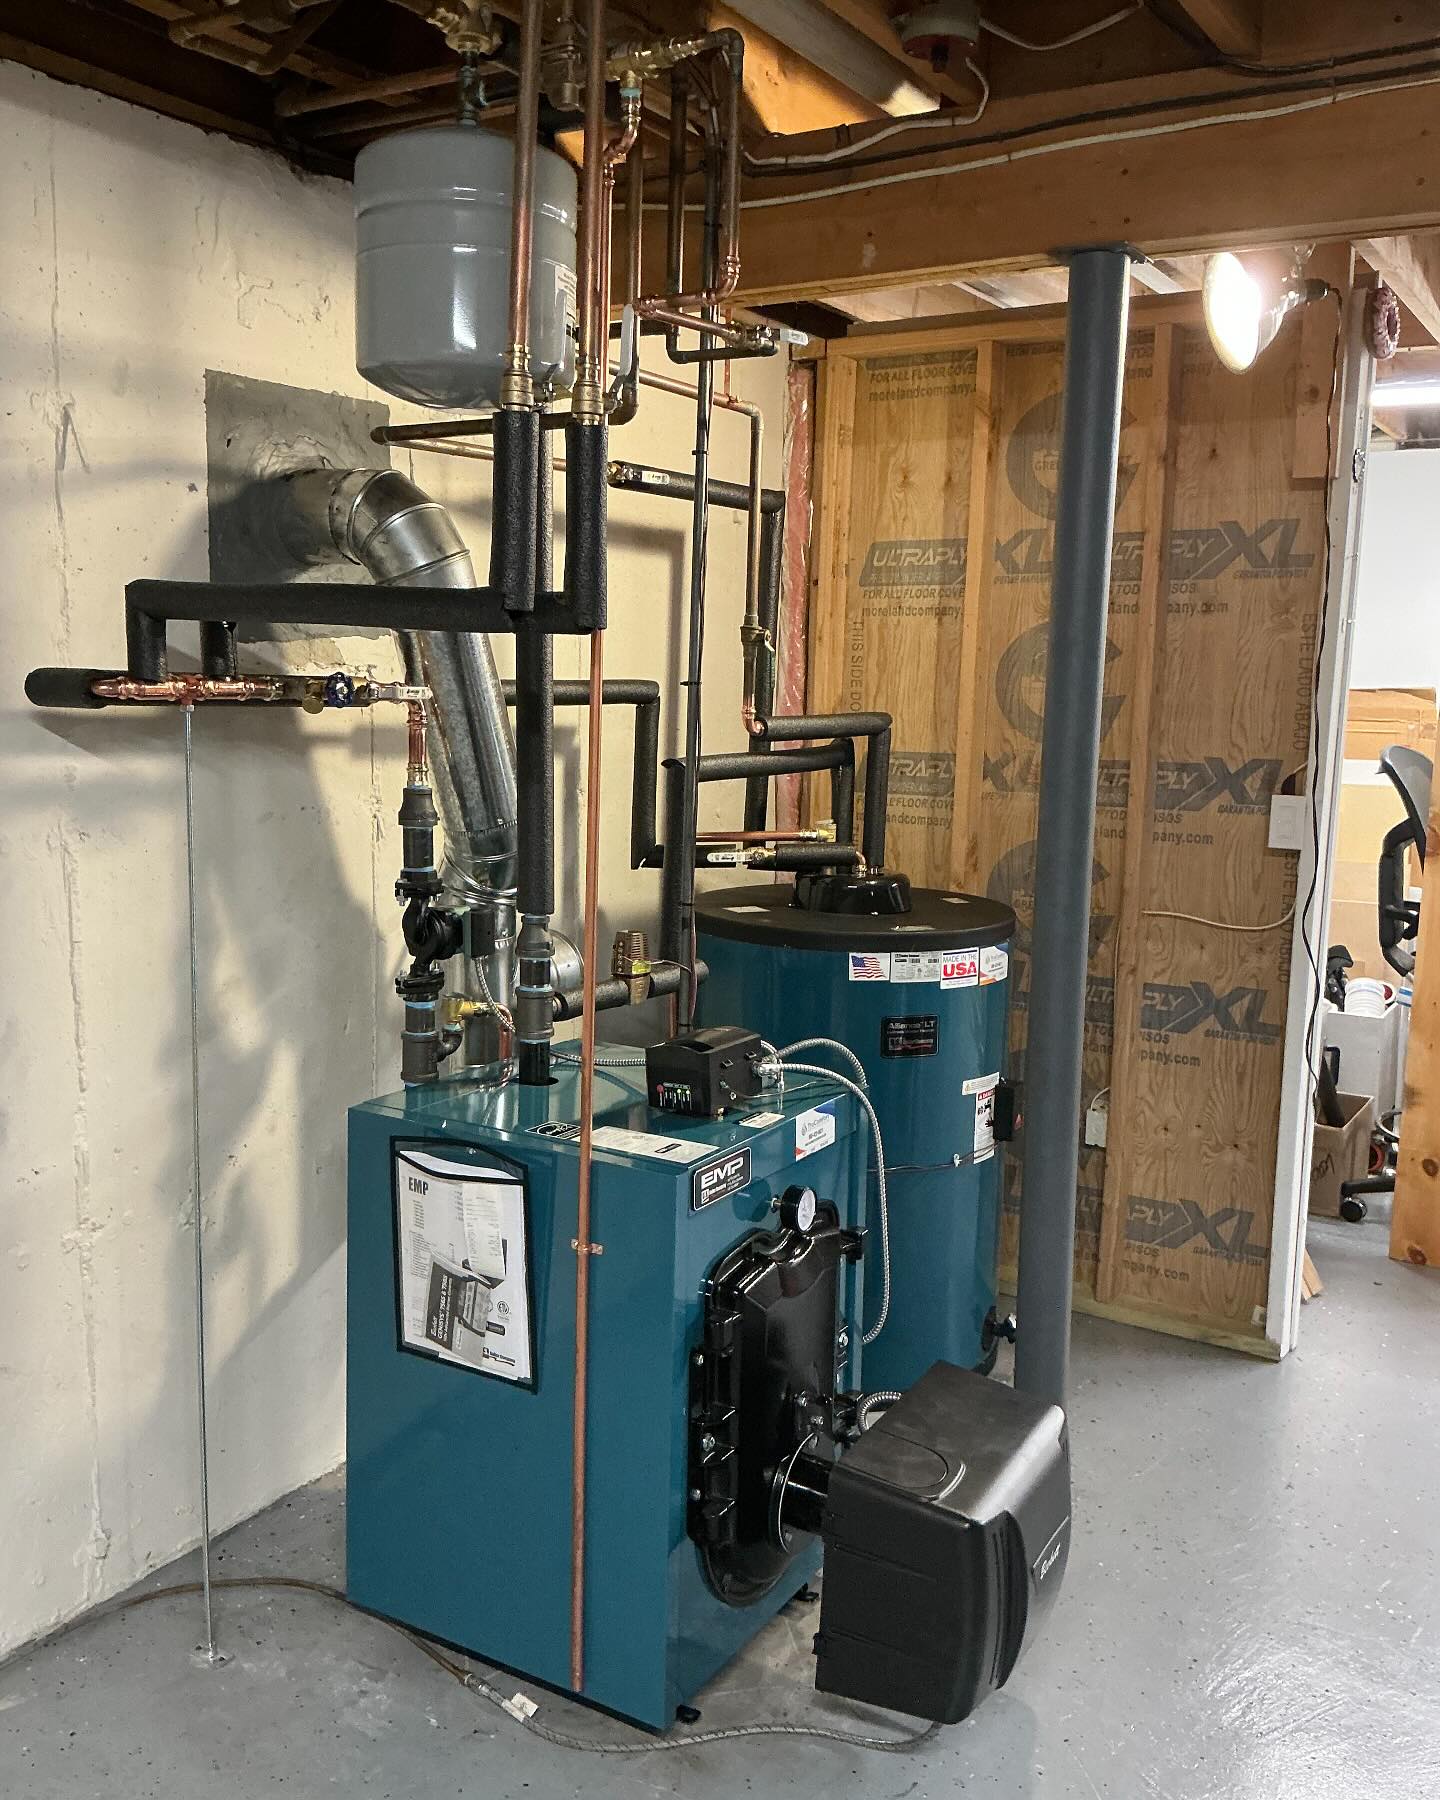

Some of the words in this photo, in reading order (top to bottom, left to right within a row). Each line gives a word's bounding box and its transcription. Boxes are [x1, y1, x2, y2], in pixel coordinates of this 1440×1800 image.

[869, 371, 890, 385] FOR
[891, 370, 910, 382] ALL
[912, 366, 946, 382] FLOOR
[948, 362, 976, 376] COVE
[869, 384, 977, 401] morelandcompany.
[1217, 518, 1316, 569] XL
[863, 588, 884, 599] FOR
[885, 587, 904, 599] ALL
[904, 587, 937, 599] FLOOR
[939, 586, 966, 598] COVE
[862, 604, 964, 620] morelandcompany.
[852, 621, 864, 651] THIS
[1300, 612, 1318, 653] ESTE
[850, 655, 863, 688] SIDE
[1297, 657, 1314, 698] LADO
[849, 691, 862, 712] DO
[1292, 702, 1311, 751] ABAJO
[943, 954, 960, 963] MADE
[961, 954, 967, 962] IN
[967, 953, 977, 961] THE
[943, 961, 977, 977] USA
[1190, 981, 1280, 1037] XL
[701, 1156, 744, 1189] EMP
[408, 1176, 429, 1196] EMP
[1128, 1204, 1175, 1227] PLY
[1177, 1198, 1270, 1258] XL
